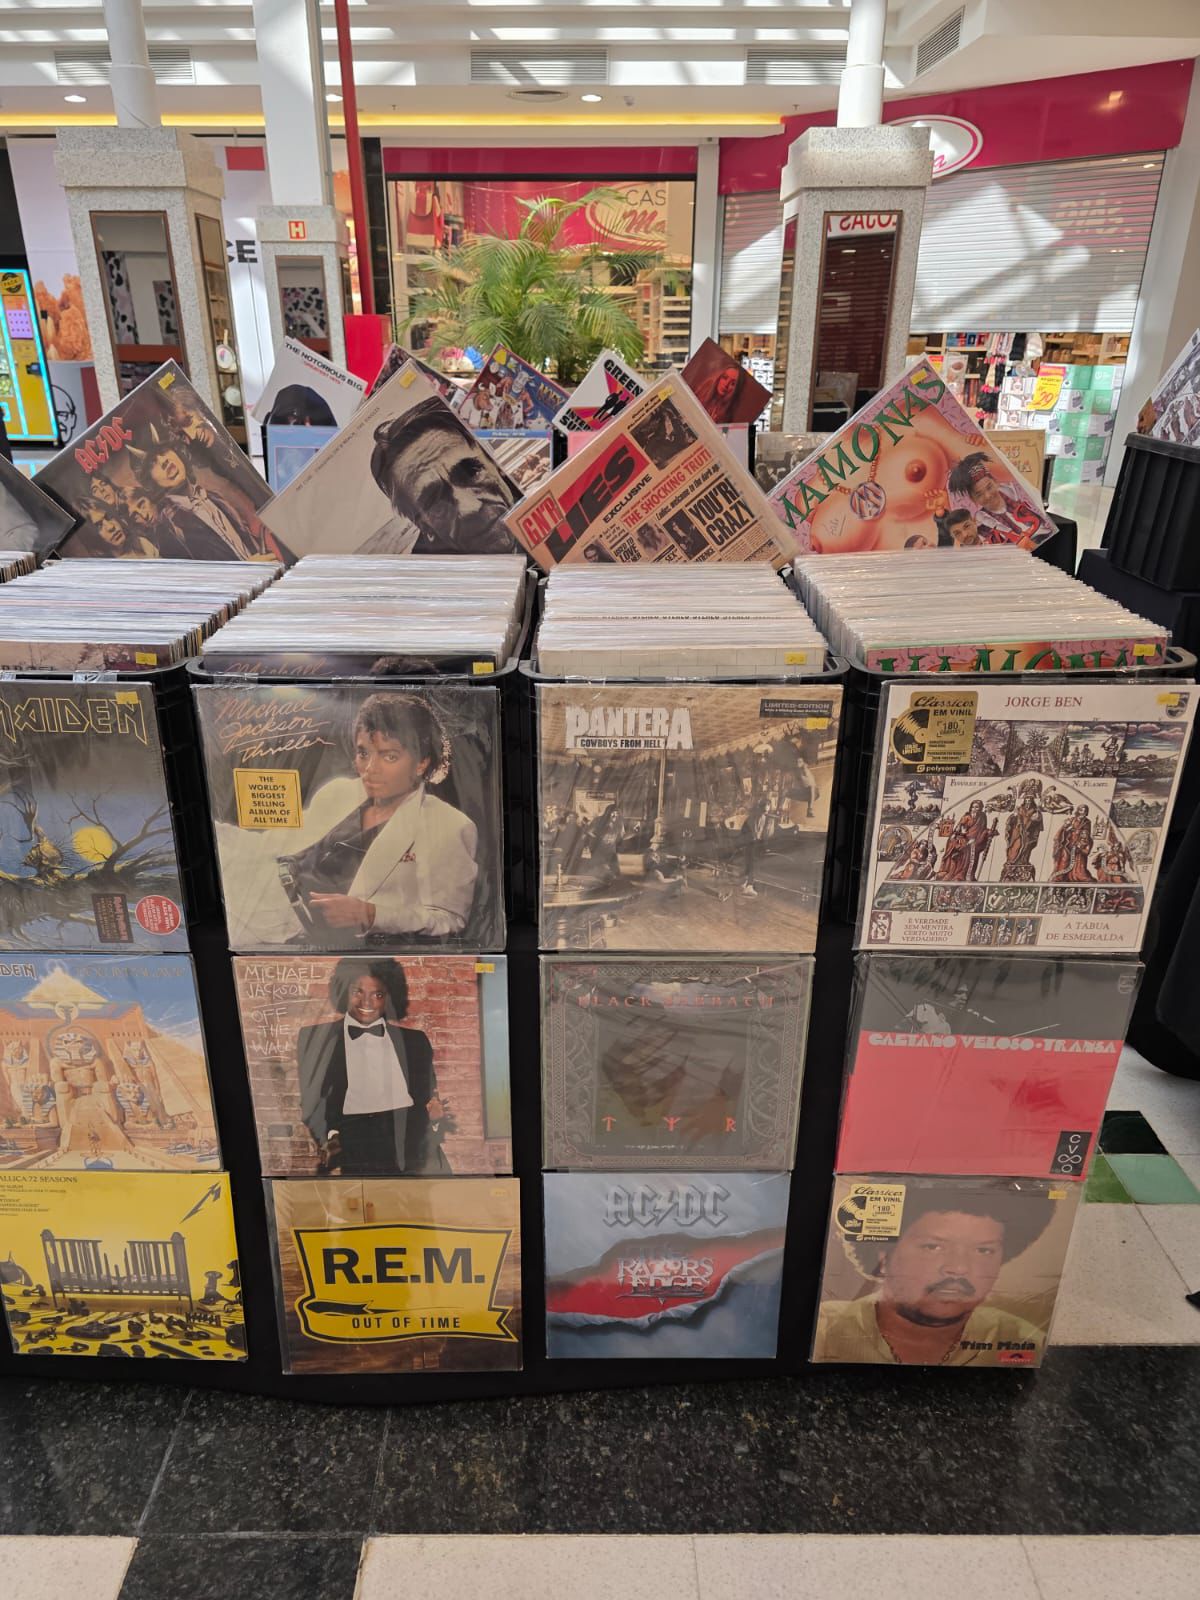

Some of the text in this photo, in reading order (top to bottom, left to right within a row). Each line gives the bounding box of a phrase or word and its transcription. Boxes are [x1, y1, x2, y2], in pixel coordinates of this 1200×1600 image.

[286, 342, 300, 353] THE
[301, 351, 346, 382] NOTORIOUS
[603, 360, 644, 397] GREEN
[74, 416, 133, 475] AC/DC
[602, 473, 653, 524] EXCLUSIVE
[623, 508, 643, 528] THE
[640, 471, 686, 515] SHOCKING
[706, 499, 755, 546] CRAZY
[214, 693, 330, 724] Michael
[1004, 696, 1083, 708] JORGE BEN
[565, 706, 694, 750] PANTERA
[580, 739, 661, 748] COWBOYS FROM HELL
[1046, 932, 1124, 941] DE ESMERALDA
[244, 963, 322, 983] MICHAEL
[246, 983, 310, 1000] JACKSON
[252, 1007, 288, 1025] OFF
[256, 1024, 291, 1038] THE
[868, 1034, 957, 1047] CAETANO
[251, 1040, 292, 1056] WALL
[602, 1184, 732, 1228] AC/DC
[322, 1247, 486, 1285] R.E.M.
[352, 1317, 461, 1329] OUT OF TIME
[960, 1341, 1036, 1350] Tim Maia
